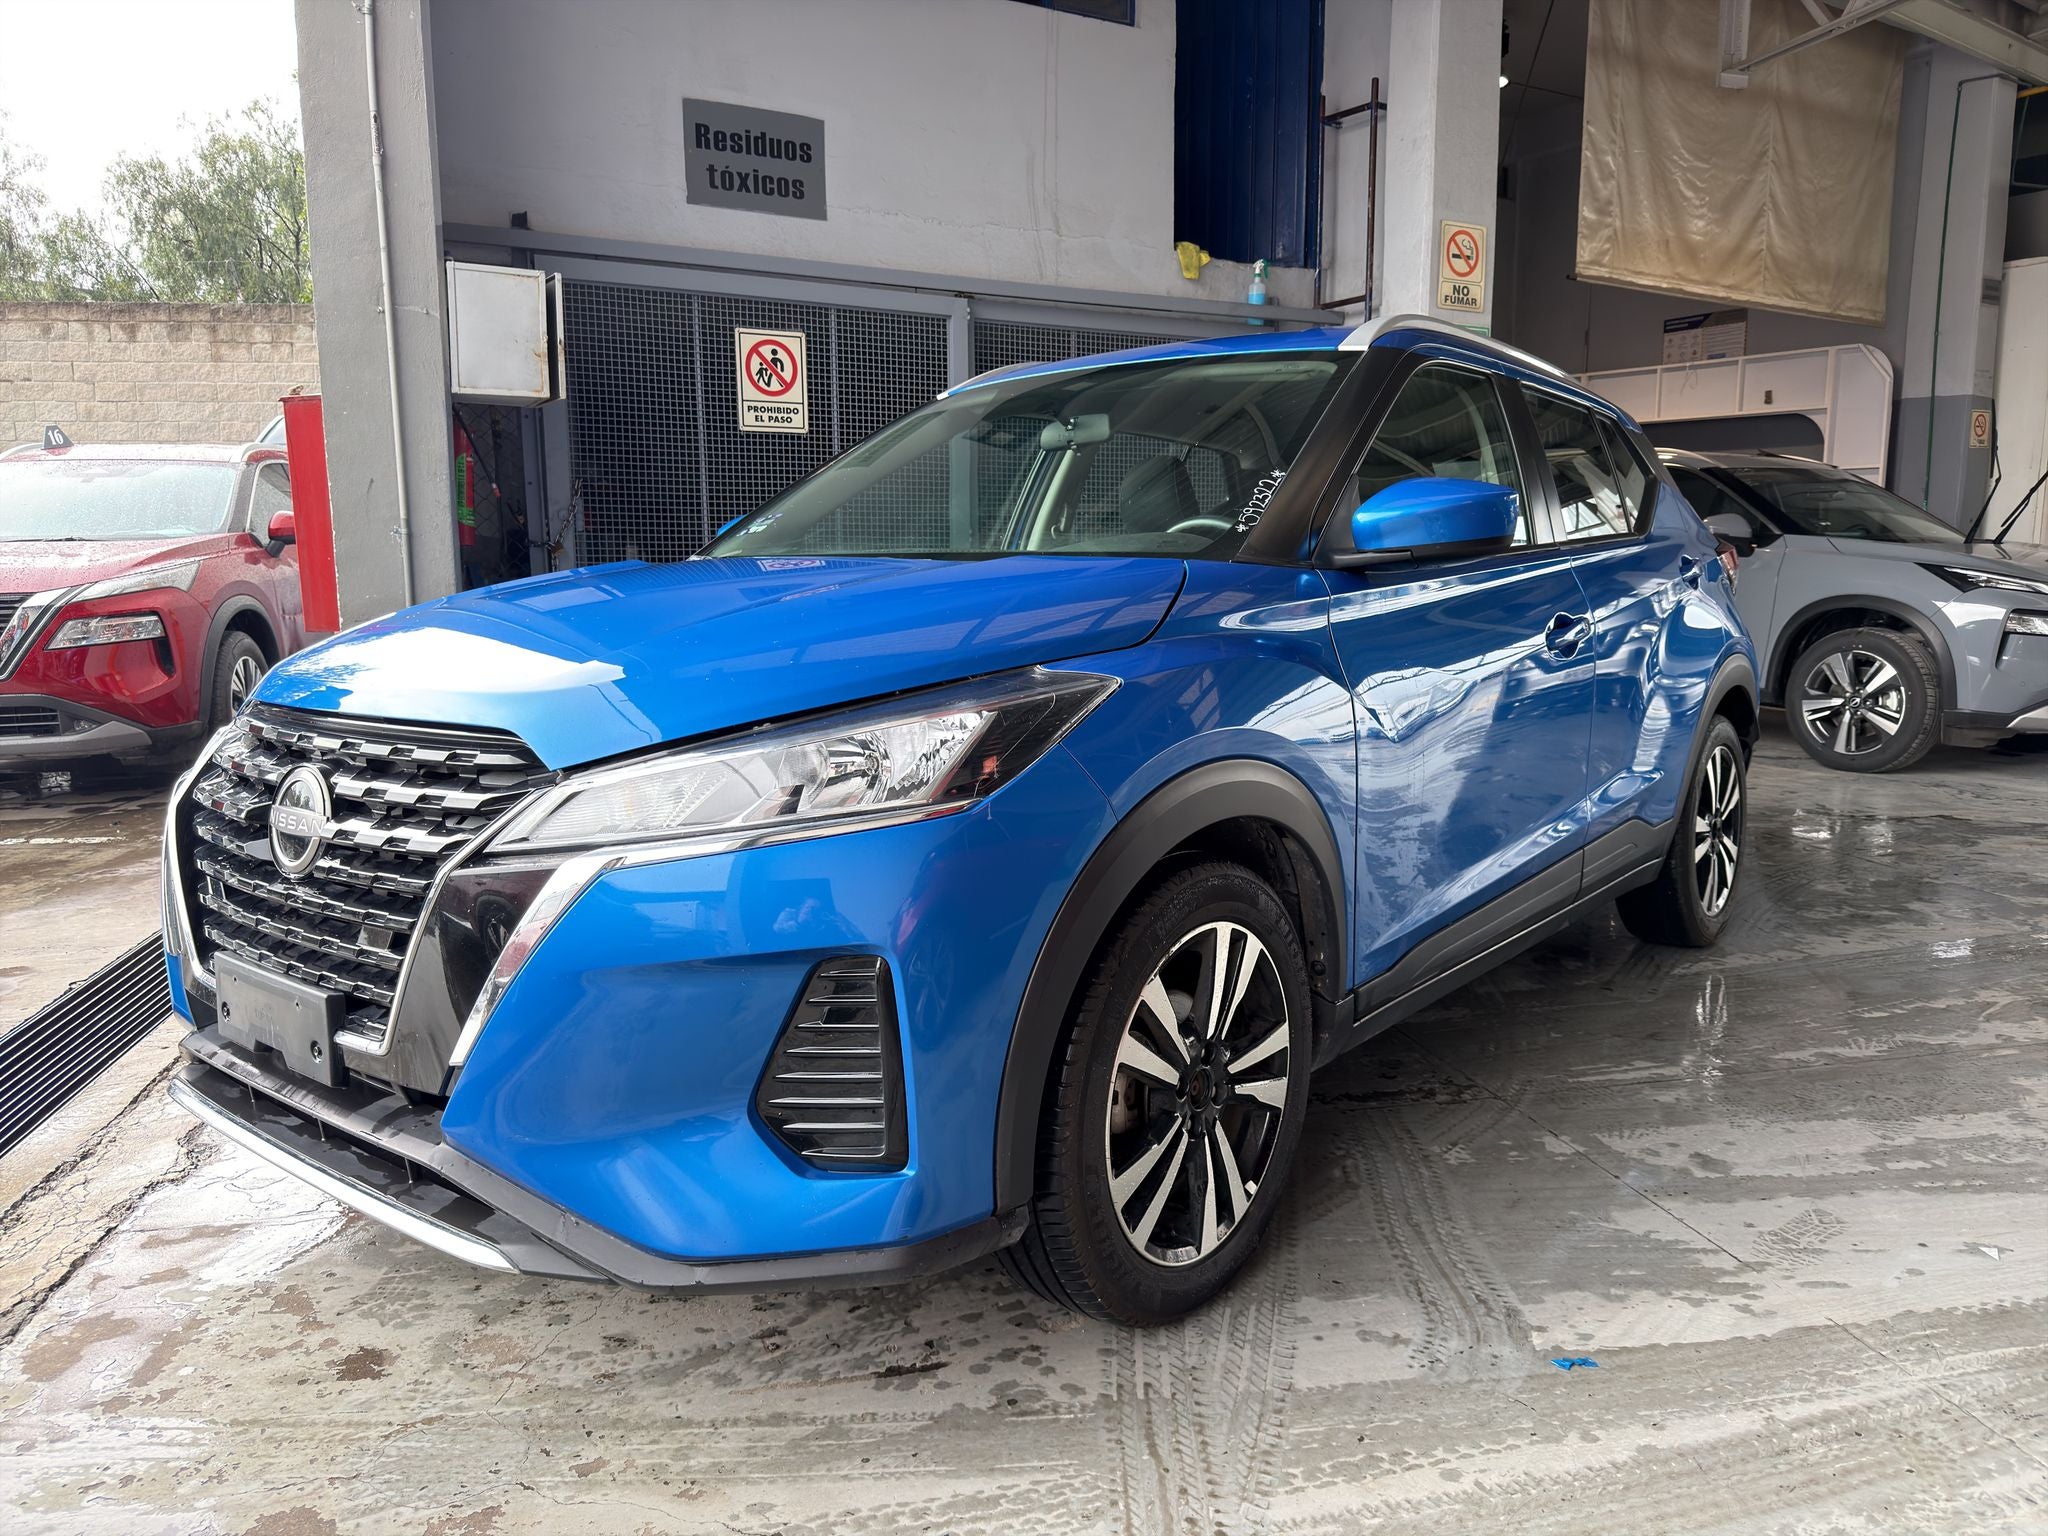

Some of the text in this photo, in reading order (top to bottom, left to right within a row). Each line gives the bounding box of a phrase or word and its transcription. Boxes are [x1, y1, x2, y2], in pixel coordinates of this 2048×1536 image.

[695, 122, 812, 163] Residuos
[706, 164, 805, 200] tóxicos
[1452, 284, 1470, 297] NO
[1444, 295, 1477, 307] FUMAR
[747, 405, 800, 415] PROHIBIDO
[754, 415, 793, 424] EL PASO
[48, 429, 64, 445] 16
[269, 808, 325, 834] NISSAN
